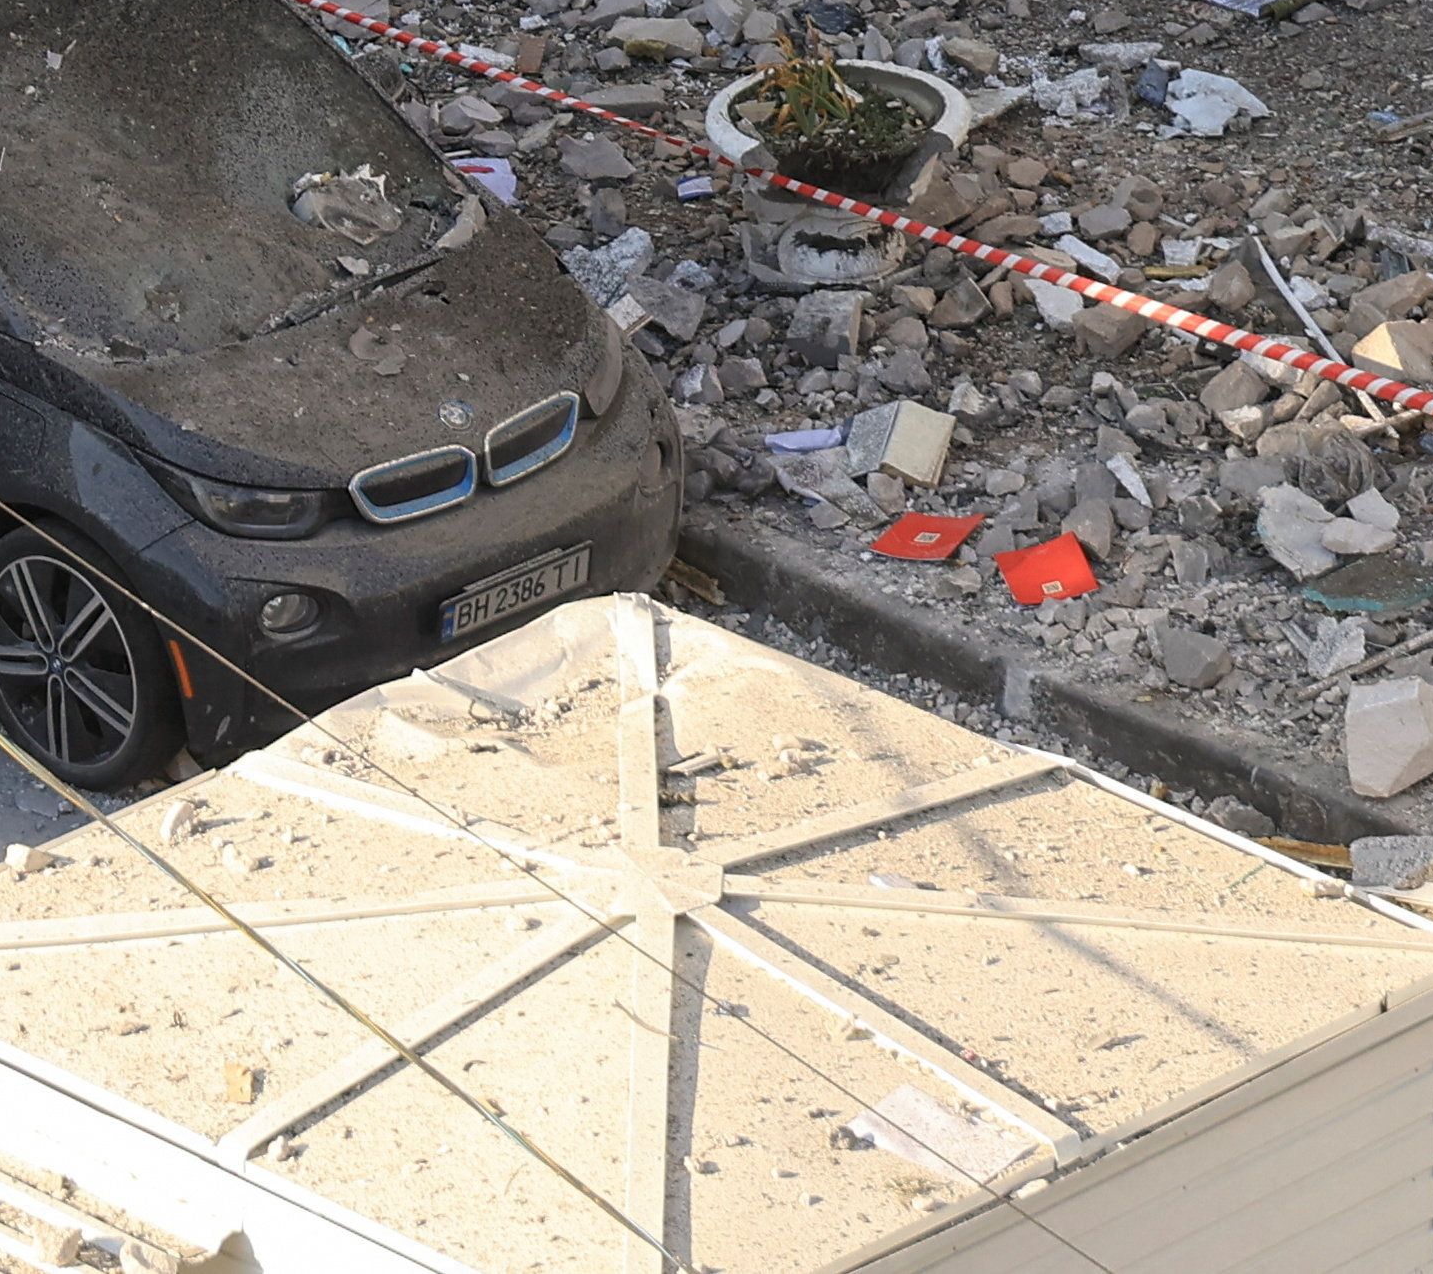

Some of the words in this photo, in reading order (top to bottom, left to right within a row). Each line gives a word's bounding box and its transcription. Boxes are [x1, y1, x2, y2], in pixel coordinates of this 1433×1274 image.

[457, 597, 488, 629] BH
[494, 571, 545, 615] 2386
[553, 555, 580, 589] TI
